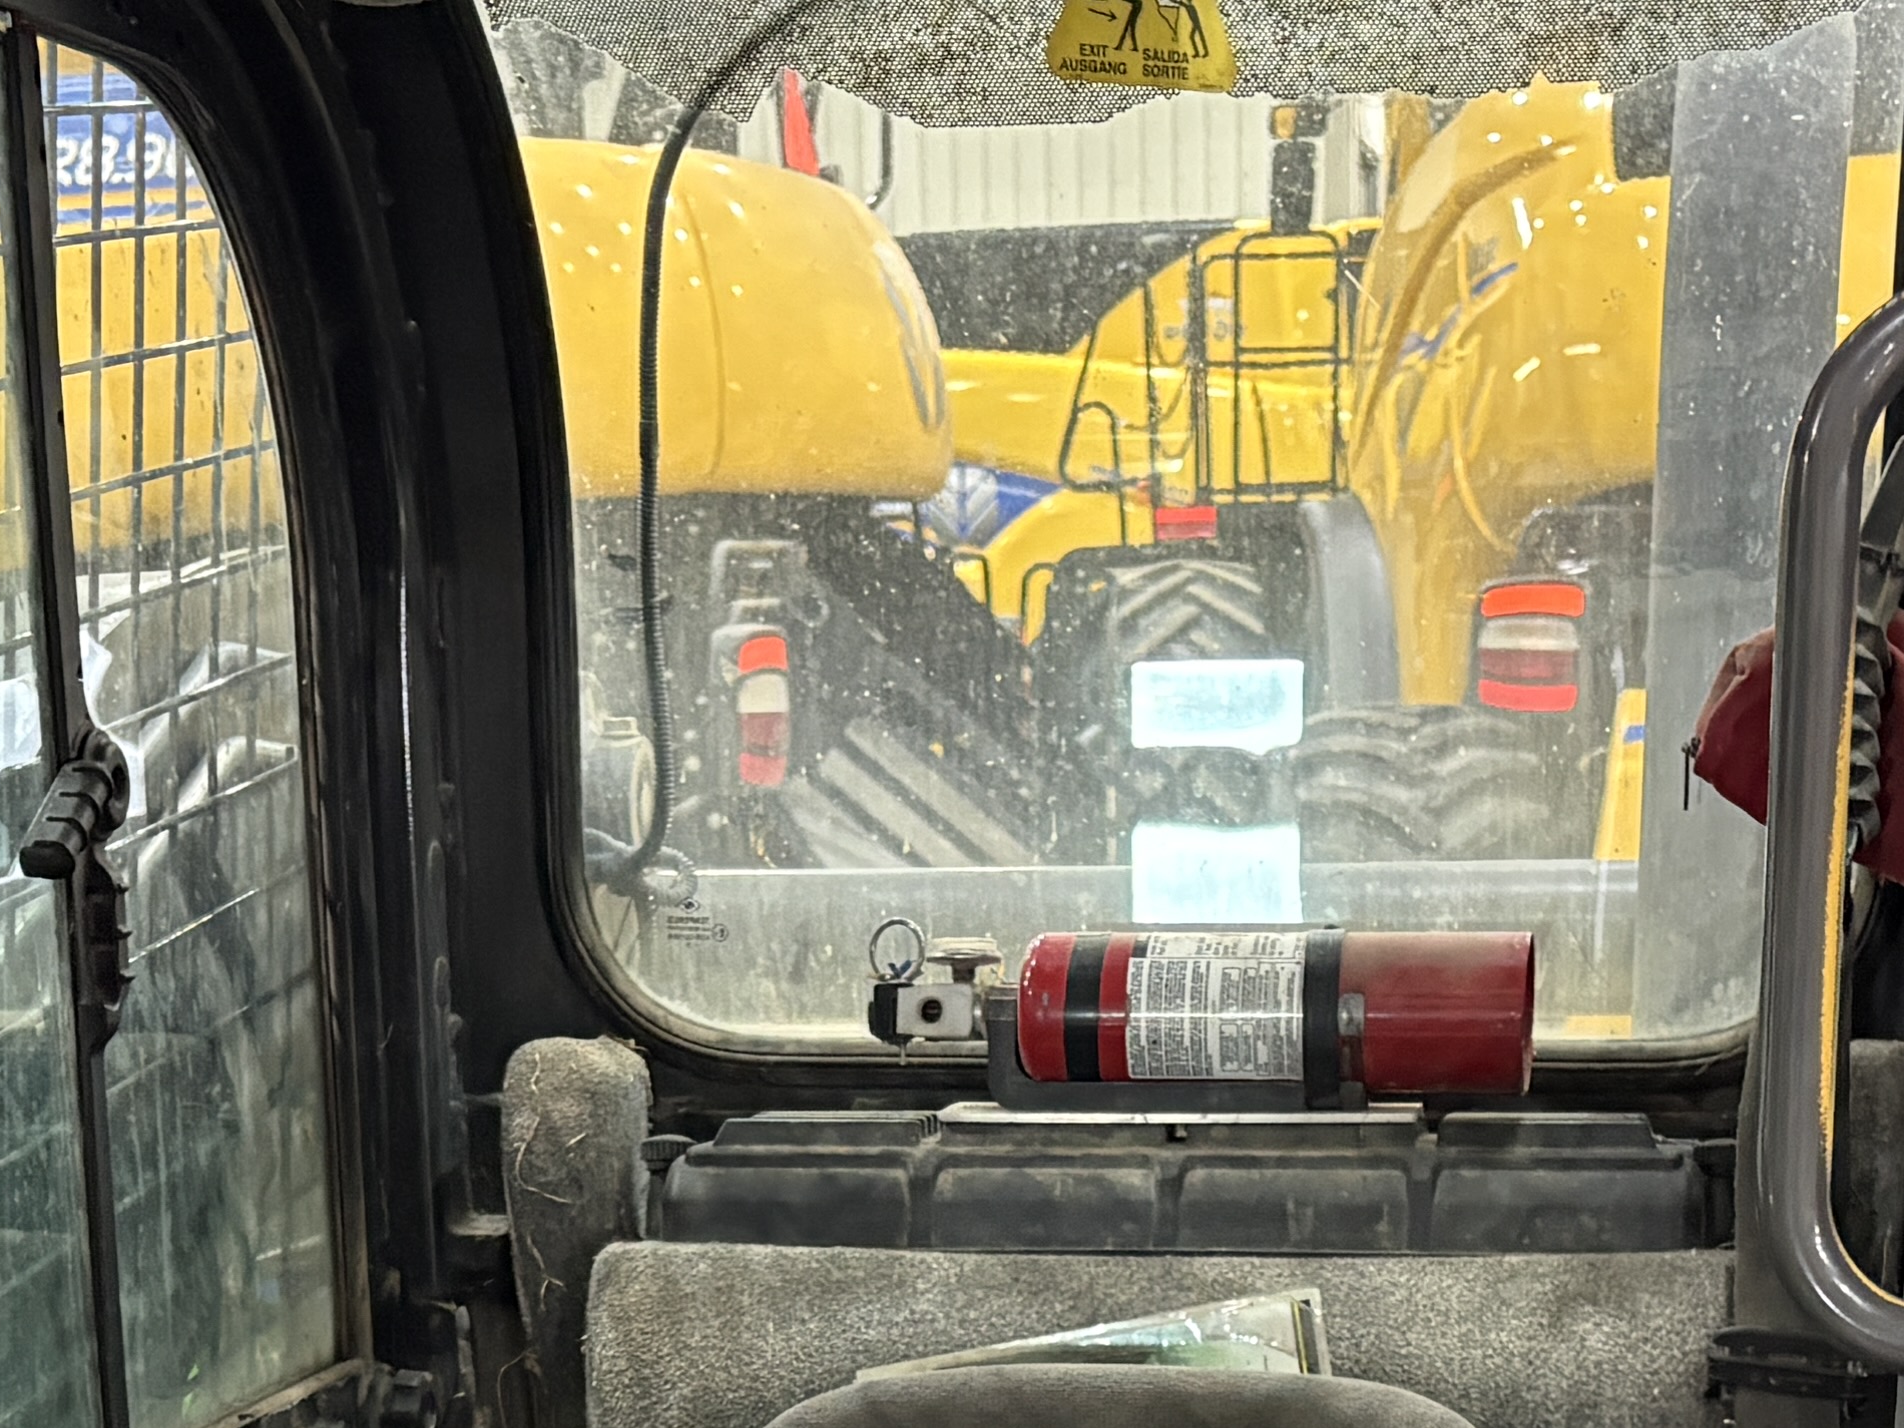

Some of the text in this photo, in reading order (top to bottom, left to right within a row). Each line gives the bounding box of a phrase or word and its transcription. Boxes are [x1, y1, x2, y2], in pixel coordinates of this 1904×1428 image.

[1079, 43, 1108, 58] EXIT
[1142, 48, 1190, 64] SALIDA
[1059, 57, 1127, 75] AUSGANG
[1142, 63, 1189, 81] SORTIE
